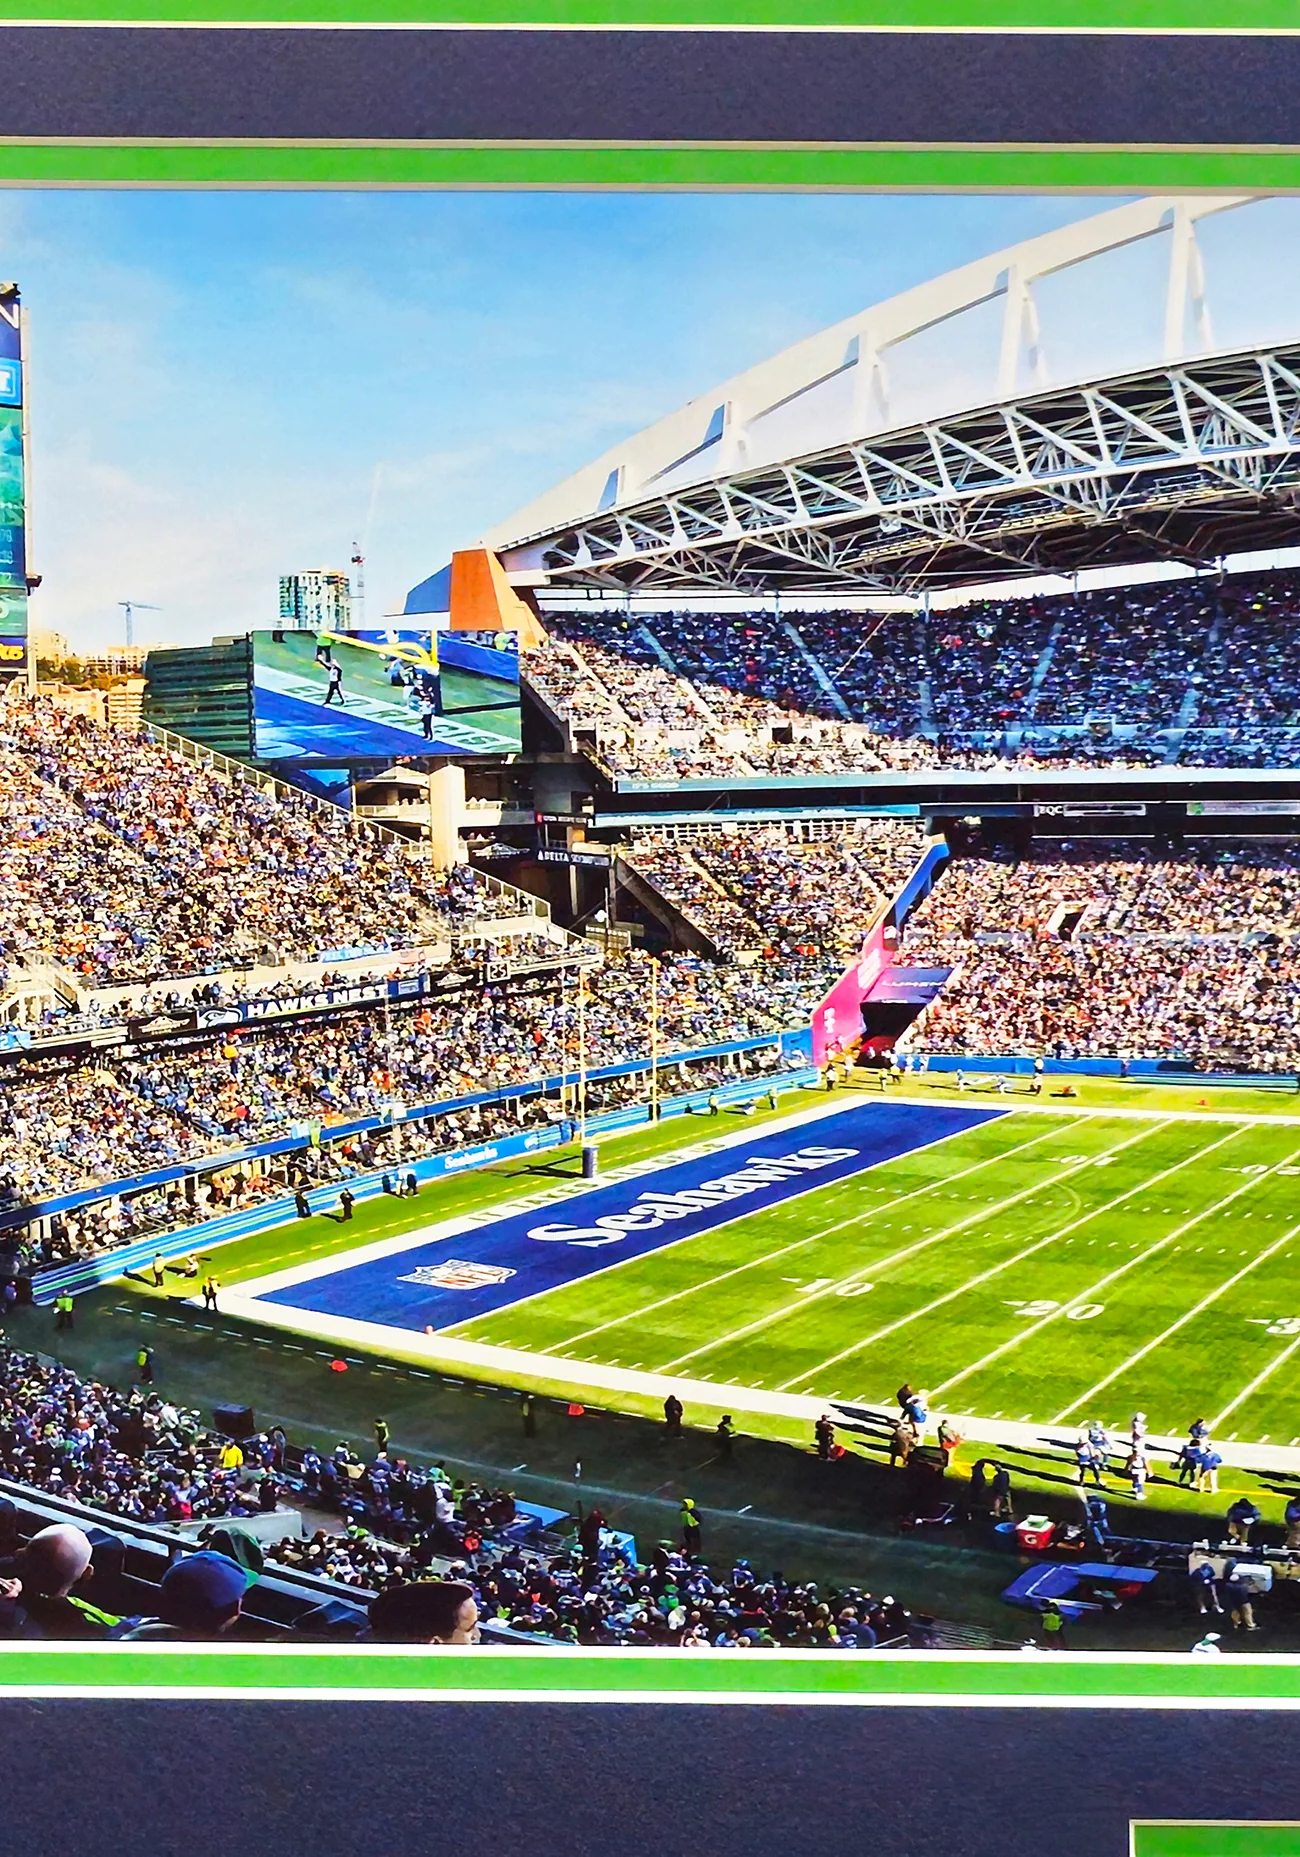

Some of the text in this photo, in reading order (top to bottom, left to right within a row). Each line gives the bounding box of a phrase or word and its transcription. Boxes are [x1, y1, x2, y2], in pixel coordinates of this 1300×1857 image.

[247, 984, 388, 1019] HAWKS NEST
[526, 1145, 861, 1248] Seahawks
[796, 1278, 876, 1297] 10
[1014, 1299, 1105, 1320] 20
[1024, 1534, 1038, 1545] G
